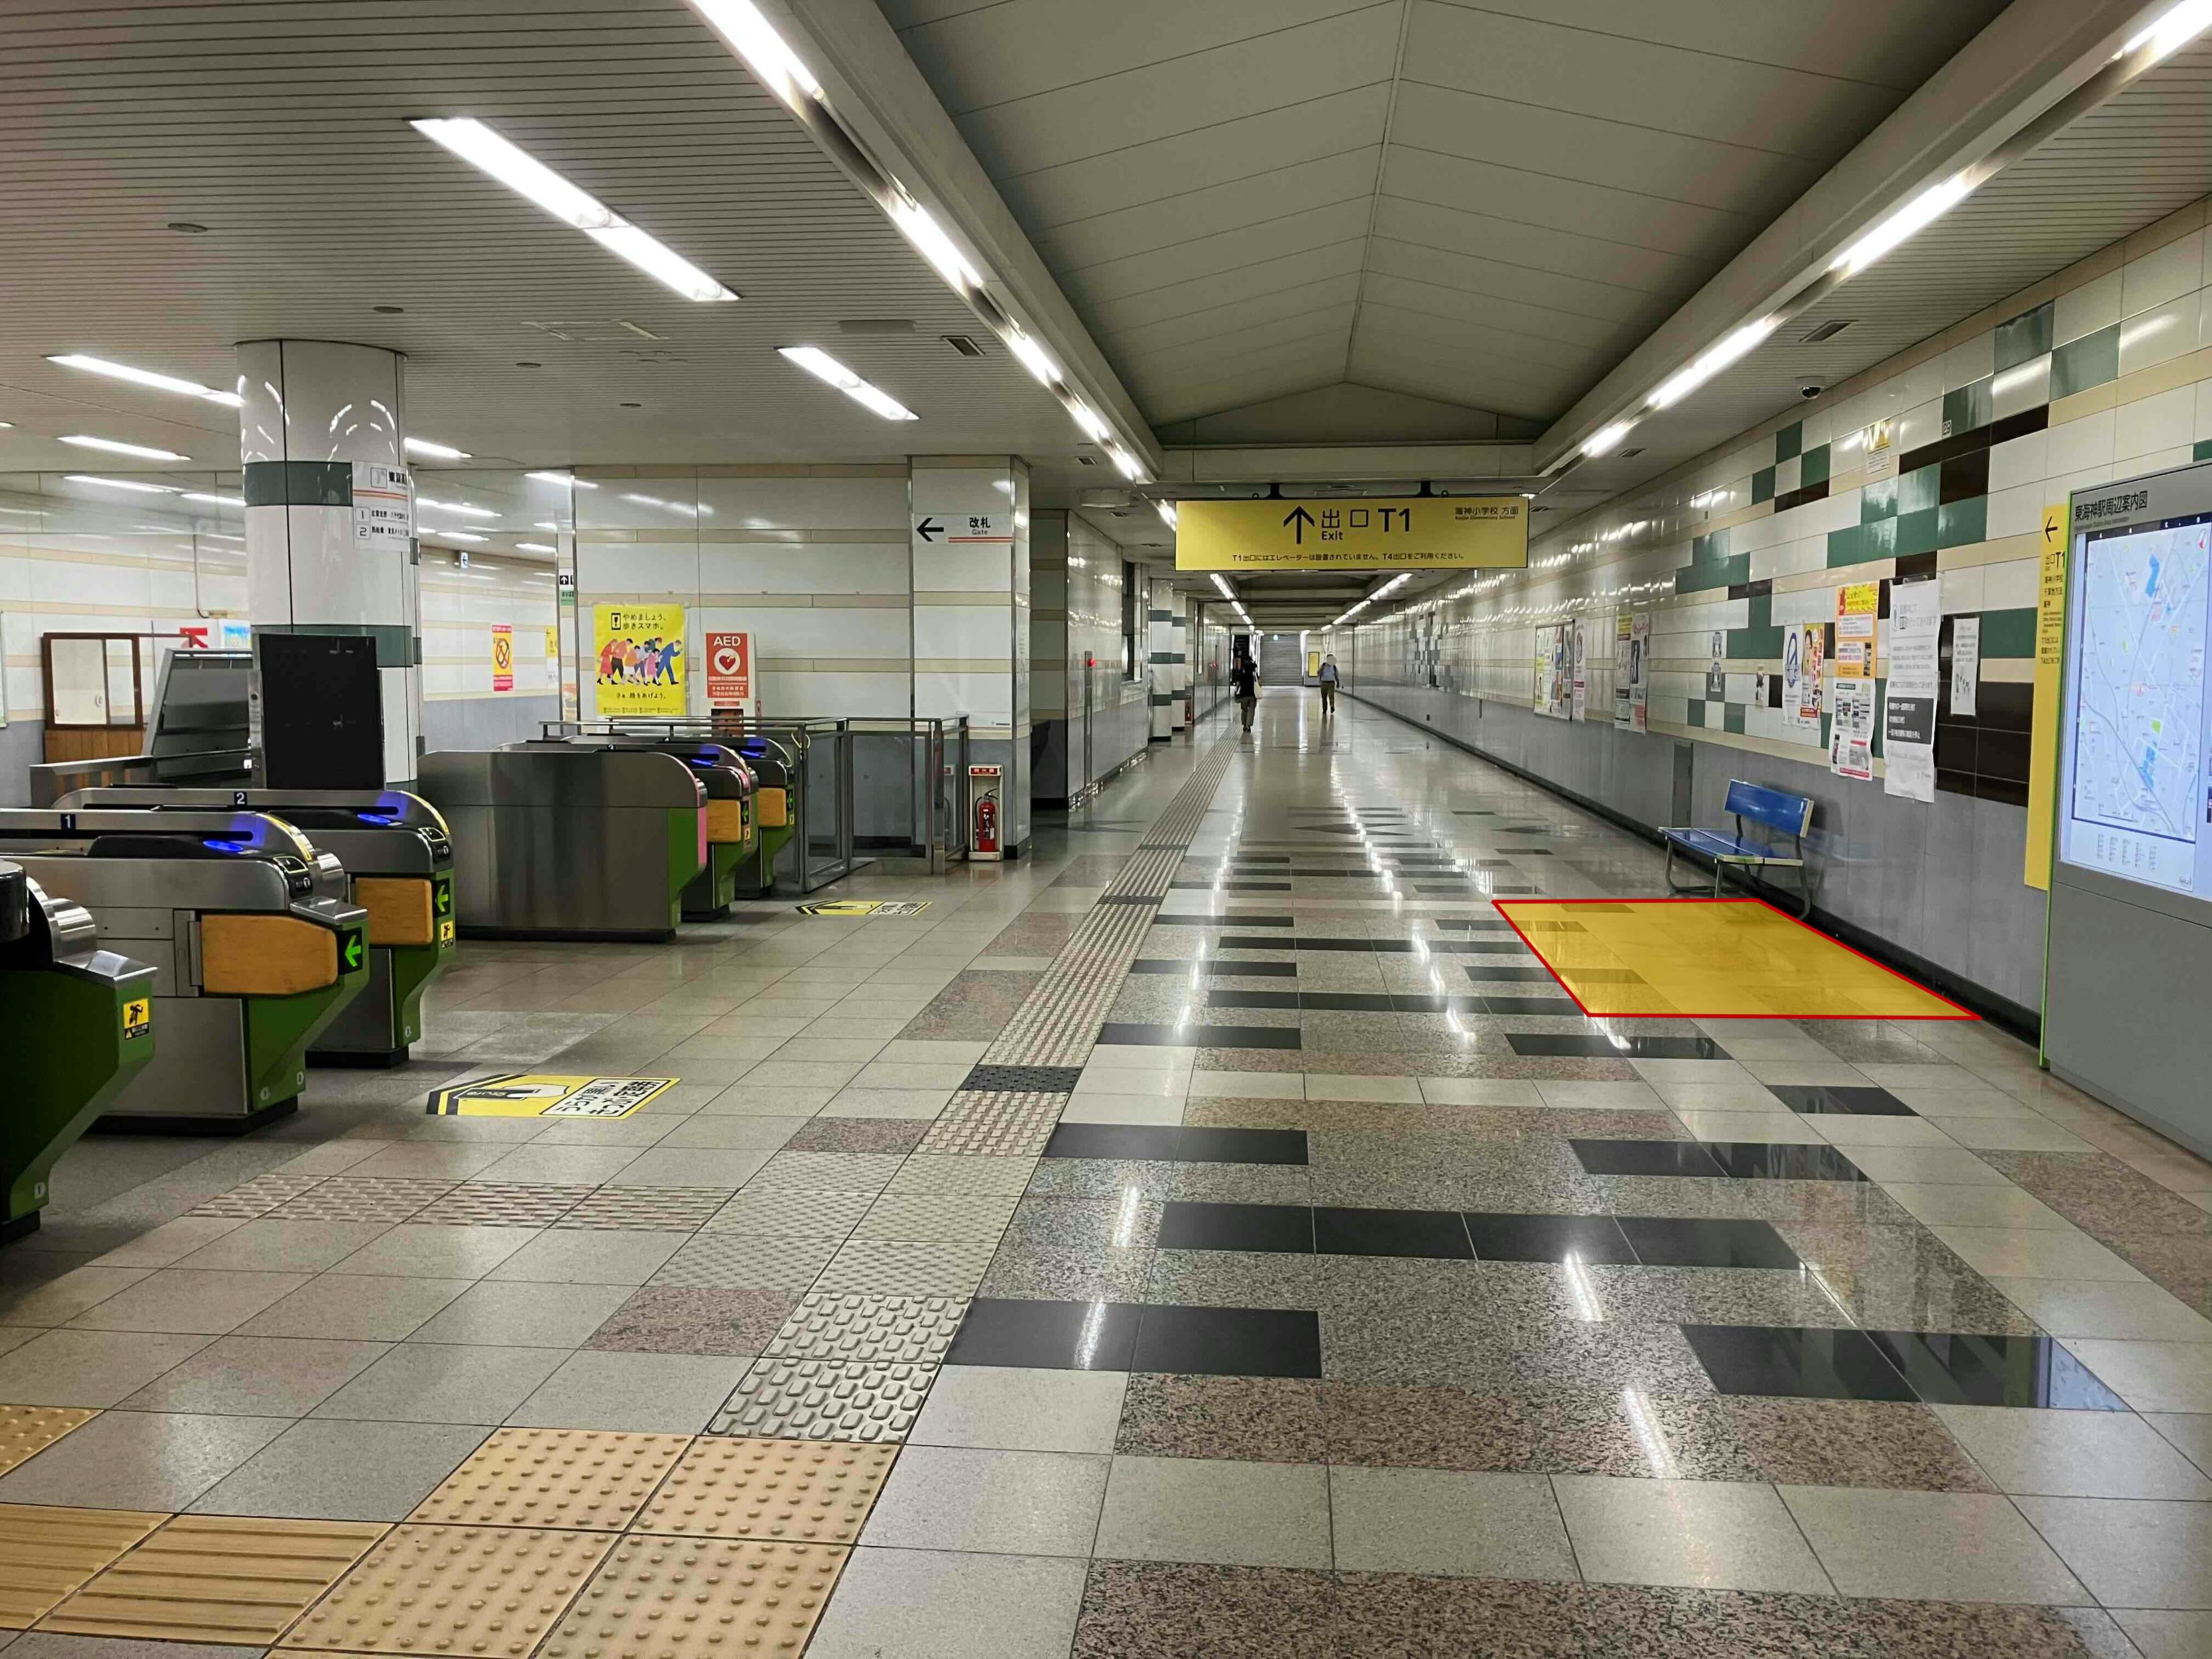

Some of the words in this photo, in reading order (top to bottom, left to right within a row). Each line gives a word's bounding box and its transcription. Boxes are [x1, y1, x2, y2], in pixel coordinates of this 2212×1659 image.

[1501, 506, 1519, 515] 方面
[2075, 491, 2148, 521] 東海神駅周辺案内図
[969, 517, 991, 528] 改札
[1322, 509, 1369, 528] 出口
[1378, 508, 1410, 532] T1
[1322, 530, 1343, 540] Exit
[713, 636, 741, 647] AED
[236, 792, 245, 804] 2
[65, 814, 72, 828] 1
